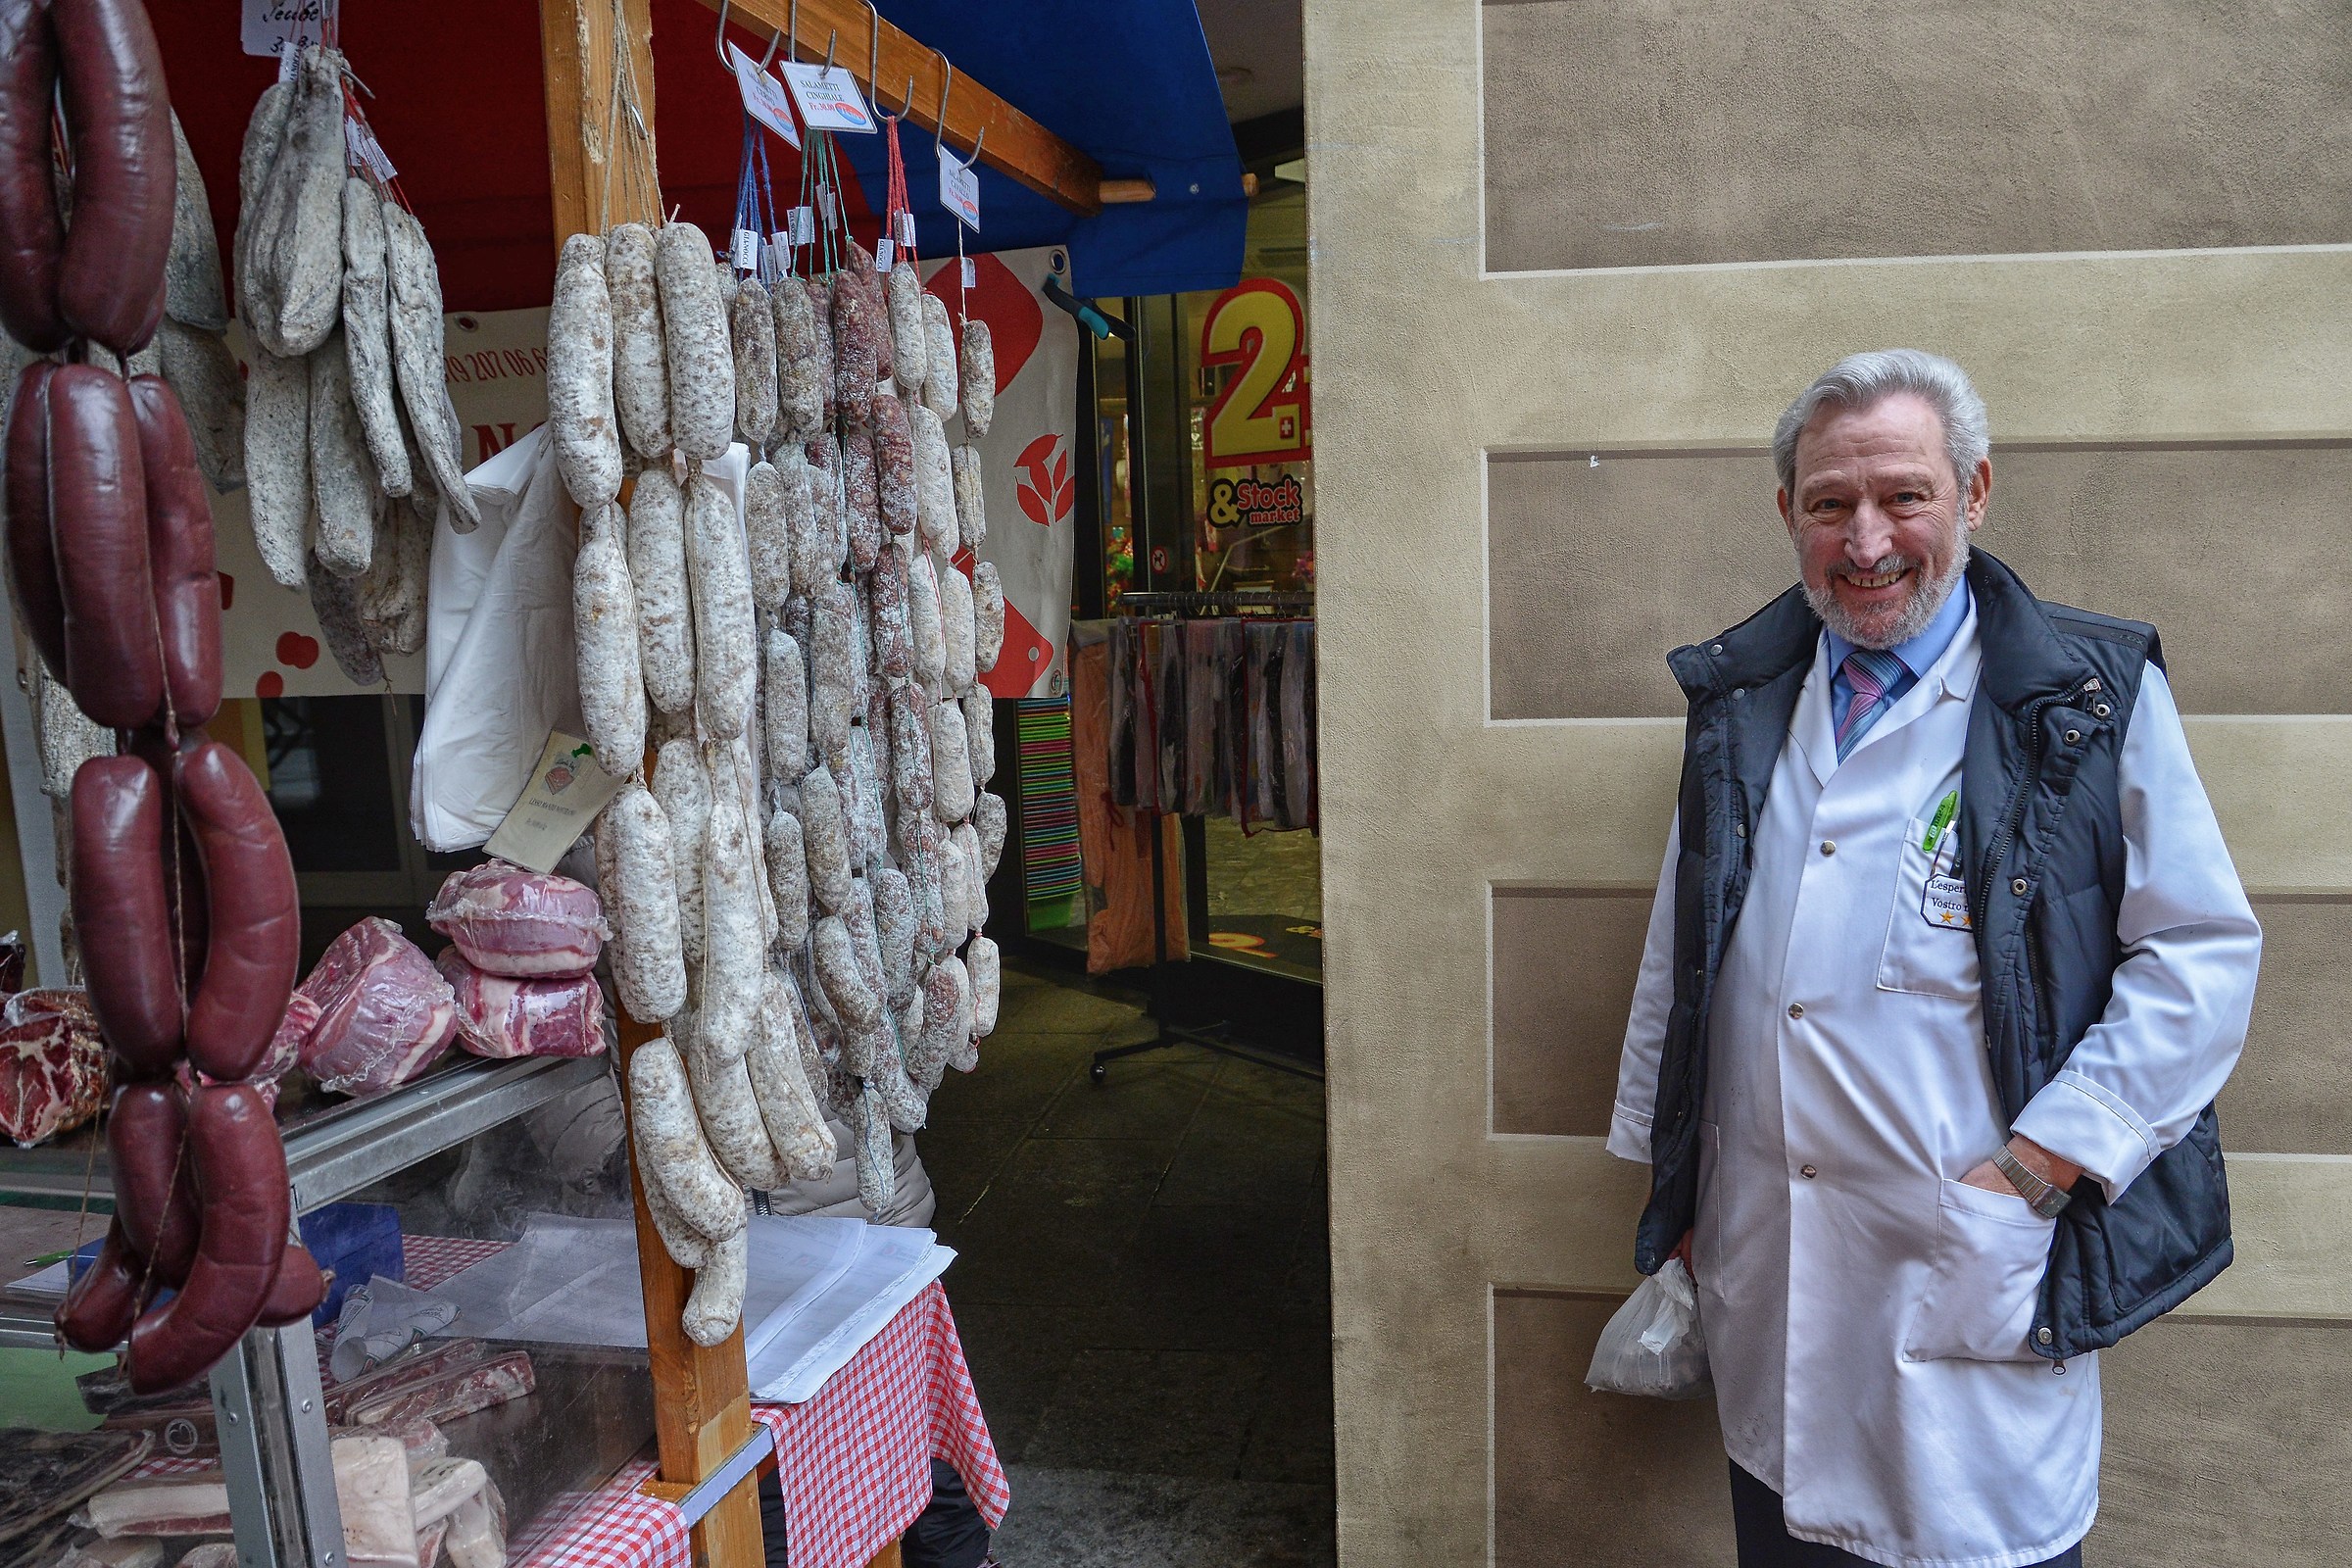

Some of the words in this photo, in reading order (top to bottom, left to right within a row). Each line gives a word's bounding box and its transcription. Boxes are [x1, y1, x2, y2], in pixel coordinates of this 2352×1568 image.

[800, 80, 841, 92] SALAMETTI
[806, 91, 846, 103] CINGHIALE
[465, 350, 508, 381] 207
[503, 348, 535, 377] 06
[531, 347, 548, 373] 6
[1210, 482, 1240, 525] &
[1237, 478, 1300, 511] Stock
[1250, 509, 1300, 525] market
[1930, 879, 1966, 894] L'esper
[1932, 897, 1963, 911] Vostro
